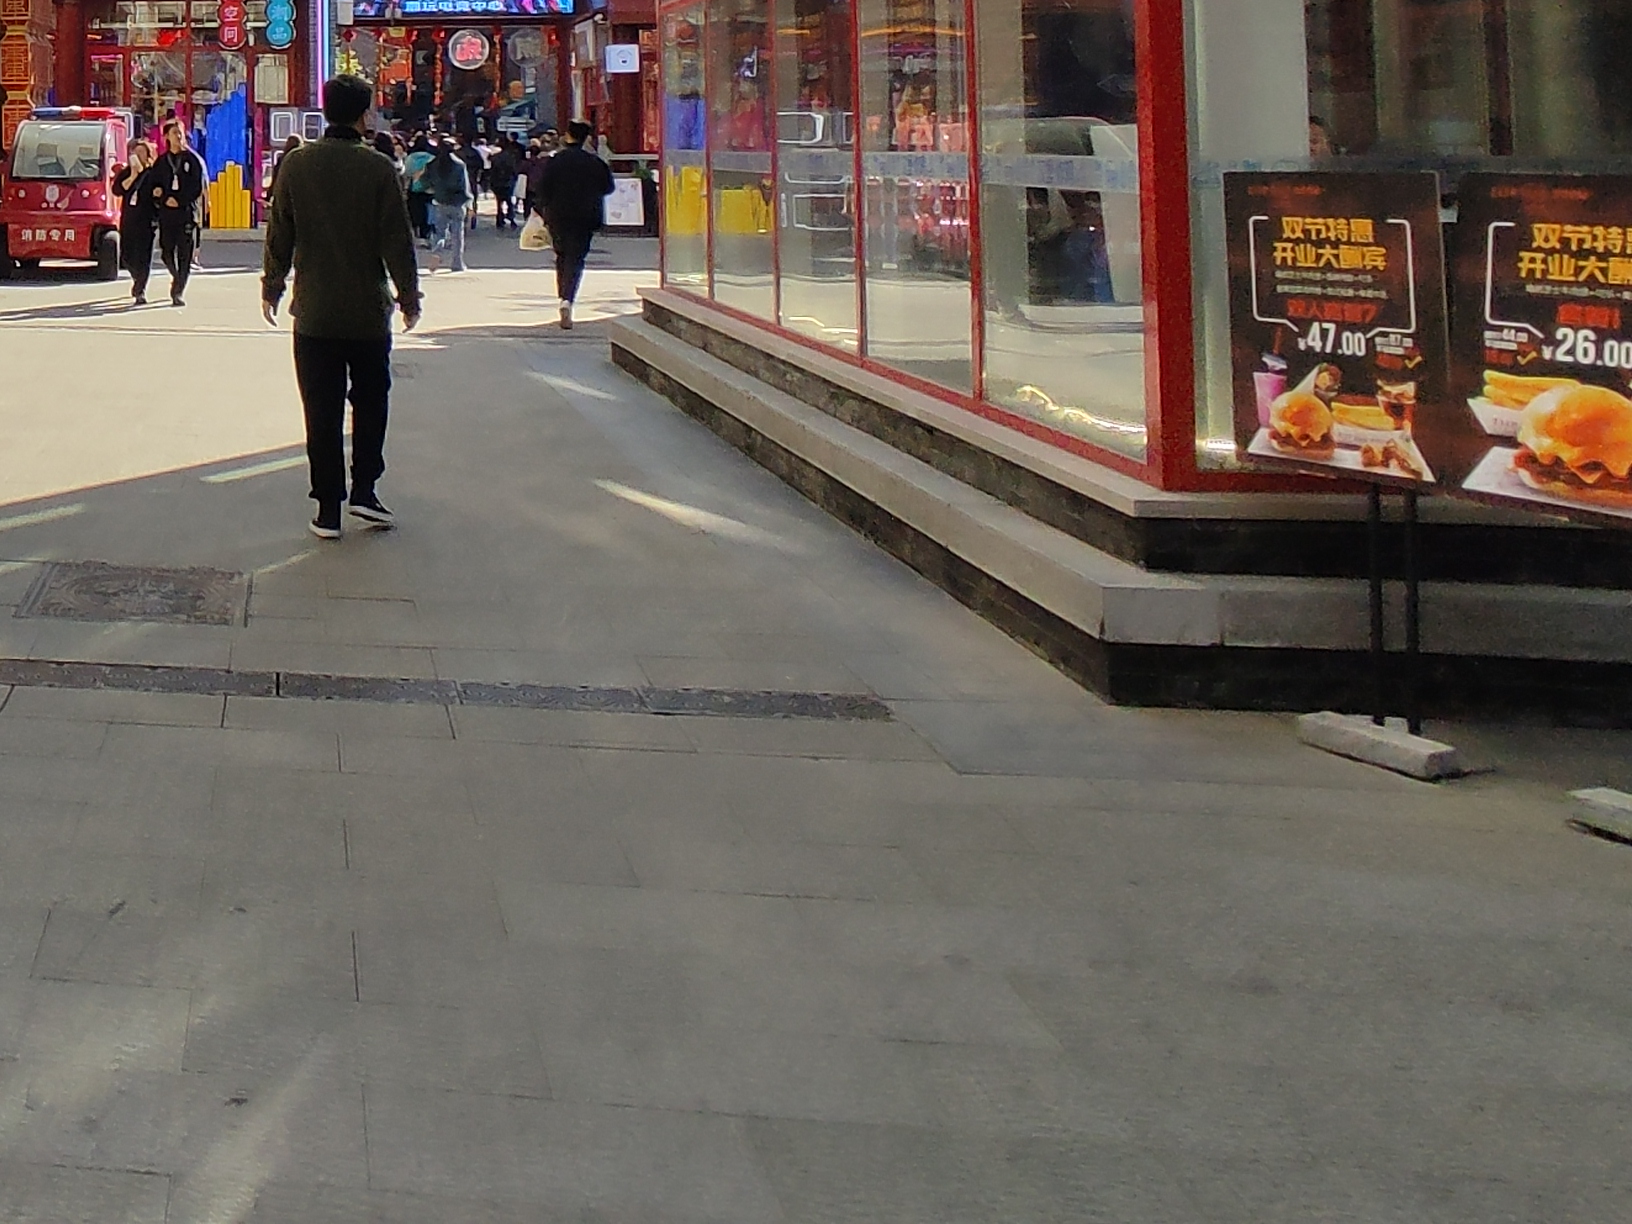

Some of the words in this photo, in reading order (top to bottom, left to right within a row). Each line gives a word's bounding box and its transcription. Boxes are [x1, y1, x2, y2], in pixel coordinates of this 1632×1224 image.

[1281, 217, 1374, 243] 双节特惠
[1532, 223, 1632, 254] 双节特
[1273, 242, 1387, 271] 开业大酬宾
